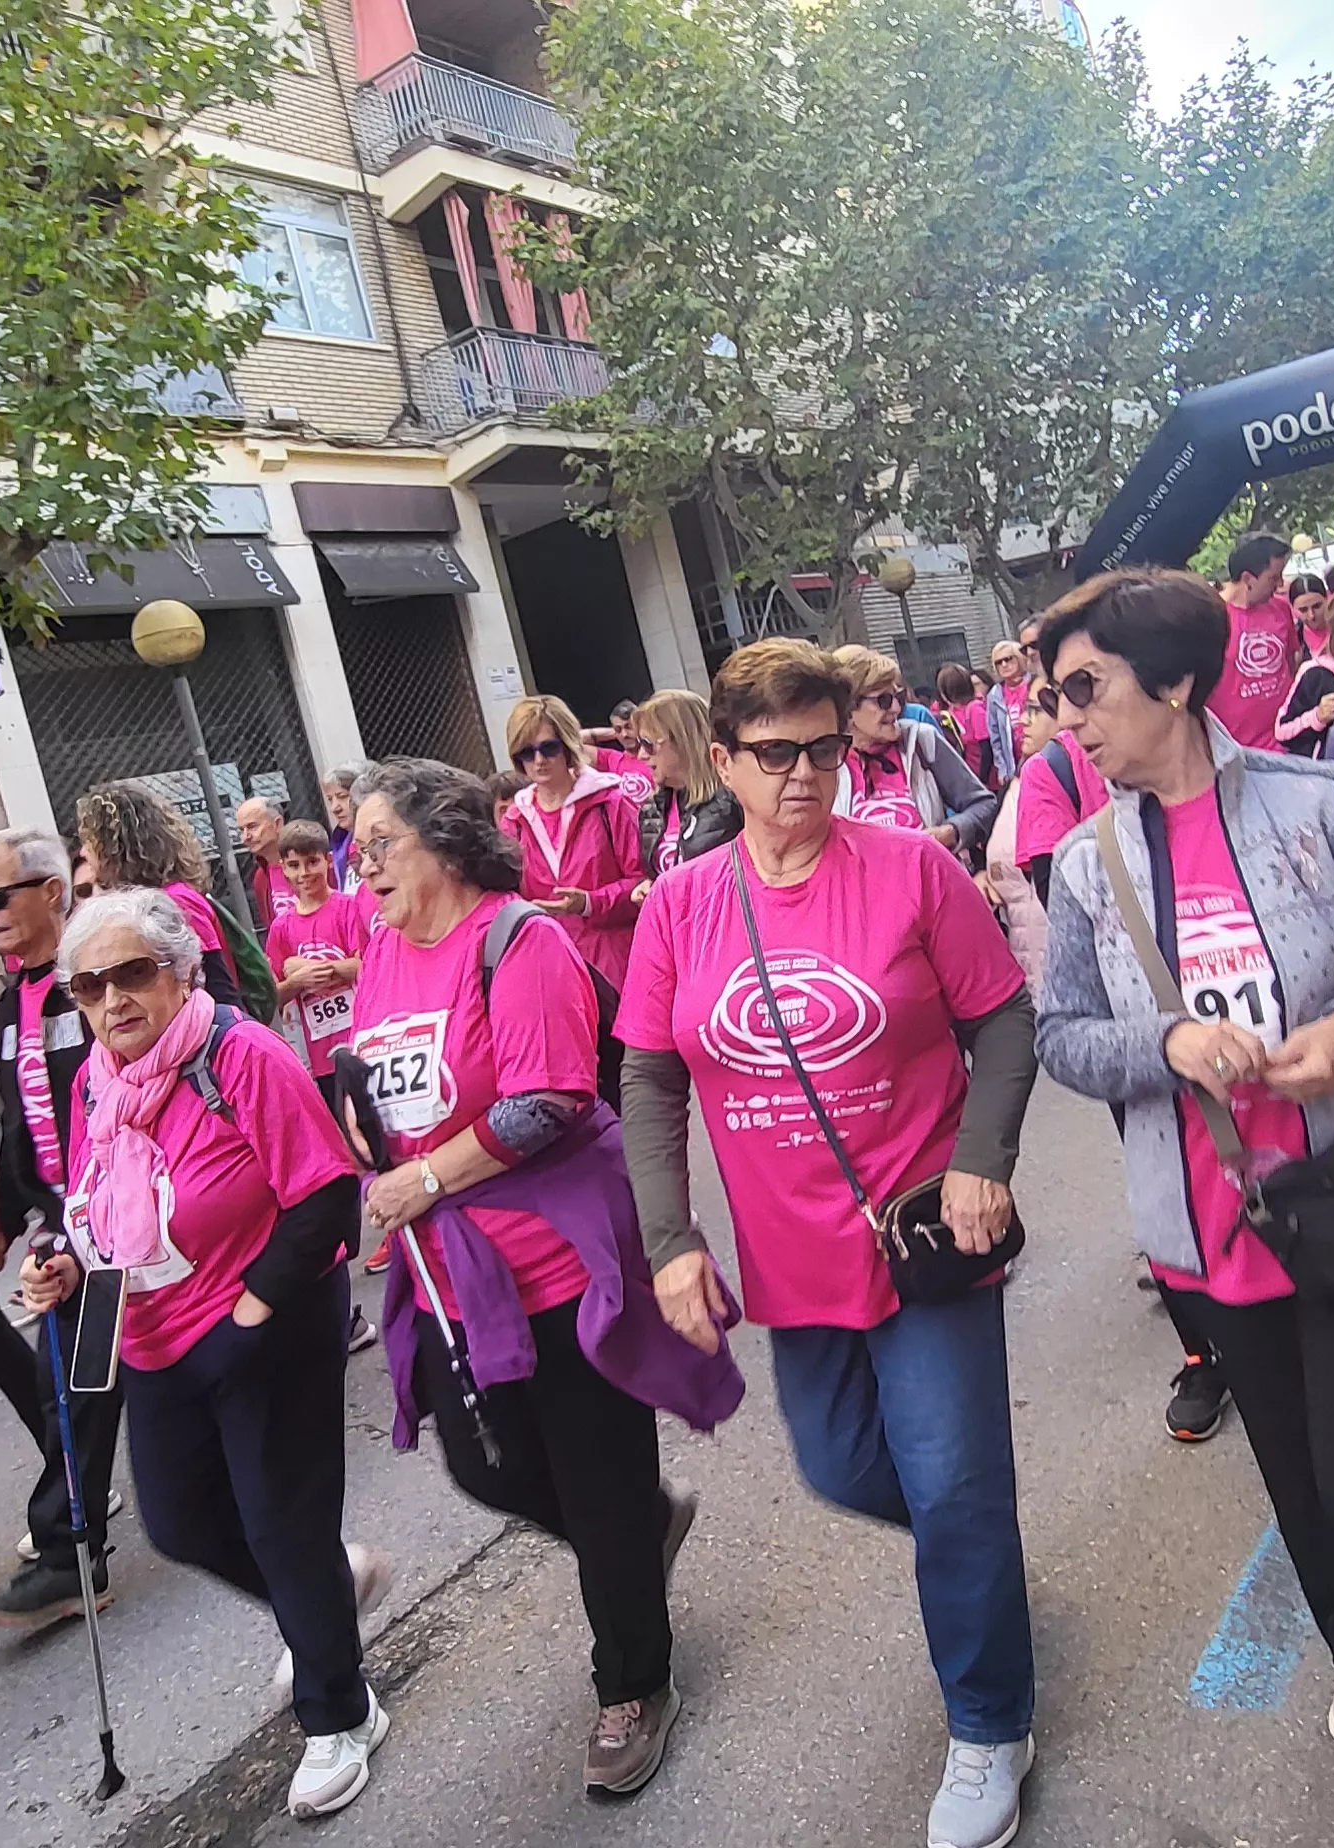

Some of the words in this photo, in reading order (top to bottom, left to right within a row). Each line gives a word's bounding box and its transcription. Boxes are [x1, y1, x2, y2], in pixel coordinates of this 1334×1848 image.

[312, 994, 350, 1024] 568
[1193, 980, 1283, 1027] 91
[368, 1052, 429, 1101] 252
